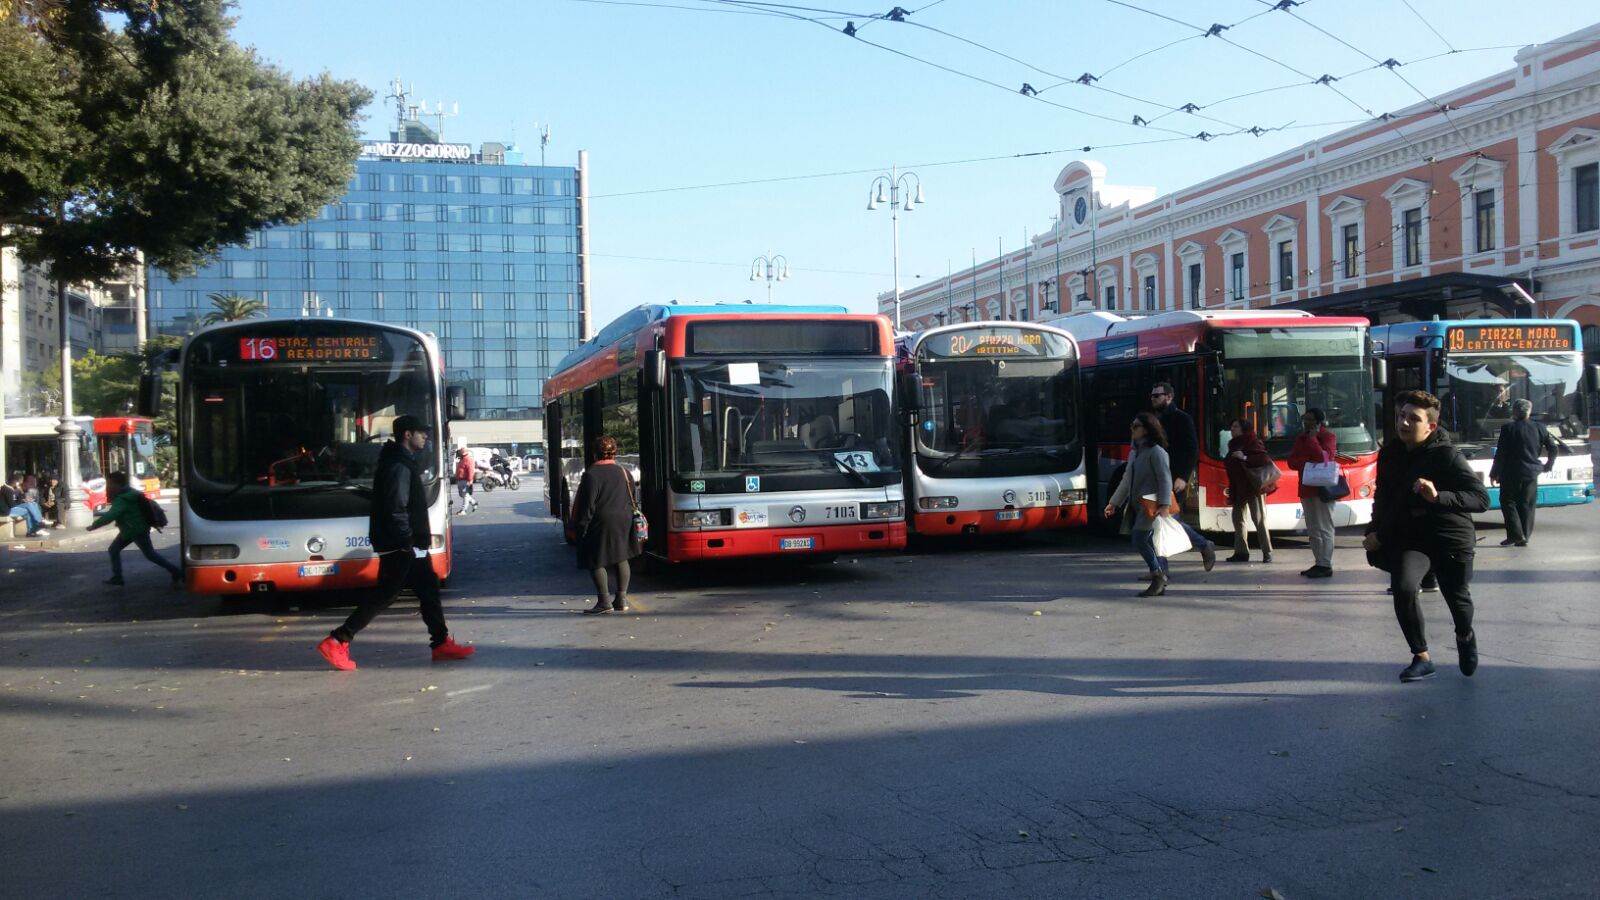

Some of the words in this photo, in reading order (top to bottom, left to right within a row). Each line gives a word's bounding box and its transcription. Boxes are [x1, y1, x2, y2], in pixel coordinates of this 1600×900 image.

[376, 142, 471, 159] MEZZOGIORNO
[1449, 328, 1465, 350] 19
[1480, 327, 1522, 340] PIAZZA
[1527, 327, 1557, 339] MORO
[246, 338, 275, 359] 16
[316, 337, 376, 347] CENTRALE
[1467, 339, 1569, 350] CATINO-ENZITEO
[287, 348, 370, 359] AEROPORTO
[842, 453, 869, 468] 13
[825, 506, 855, 519] 7103
[345, 536, 372, 548] 3026
